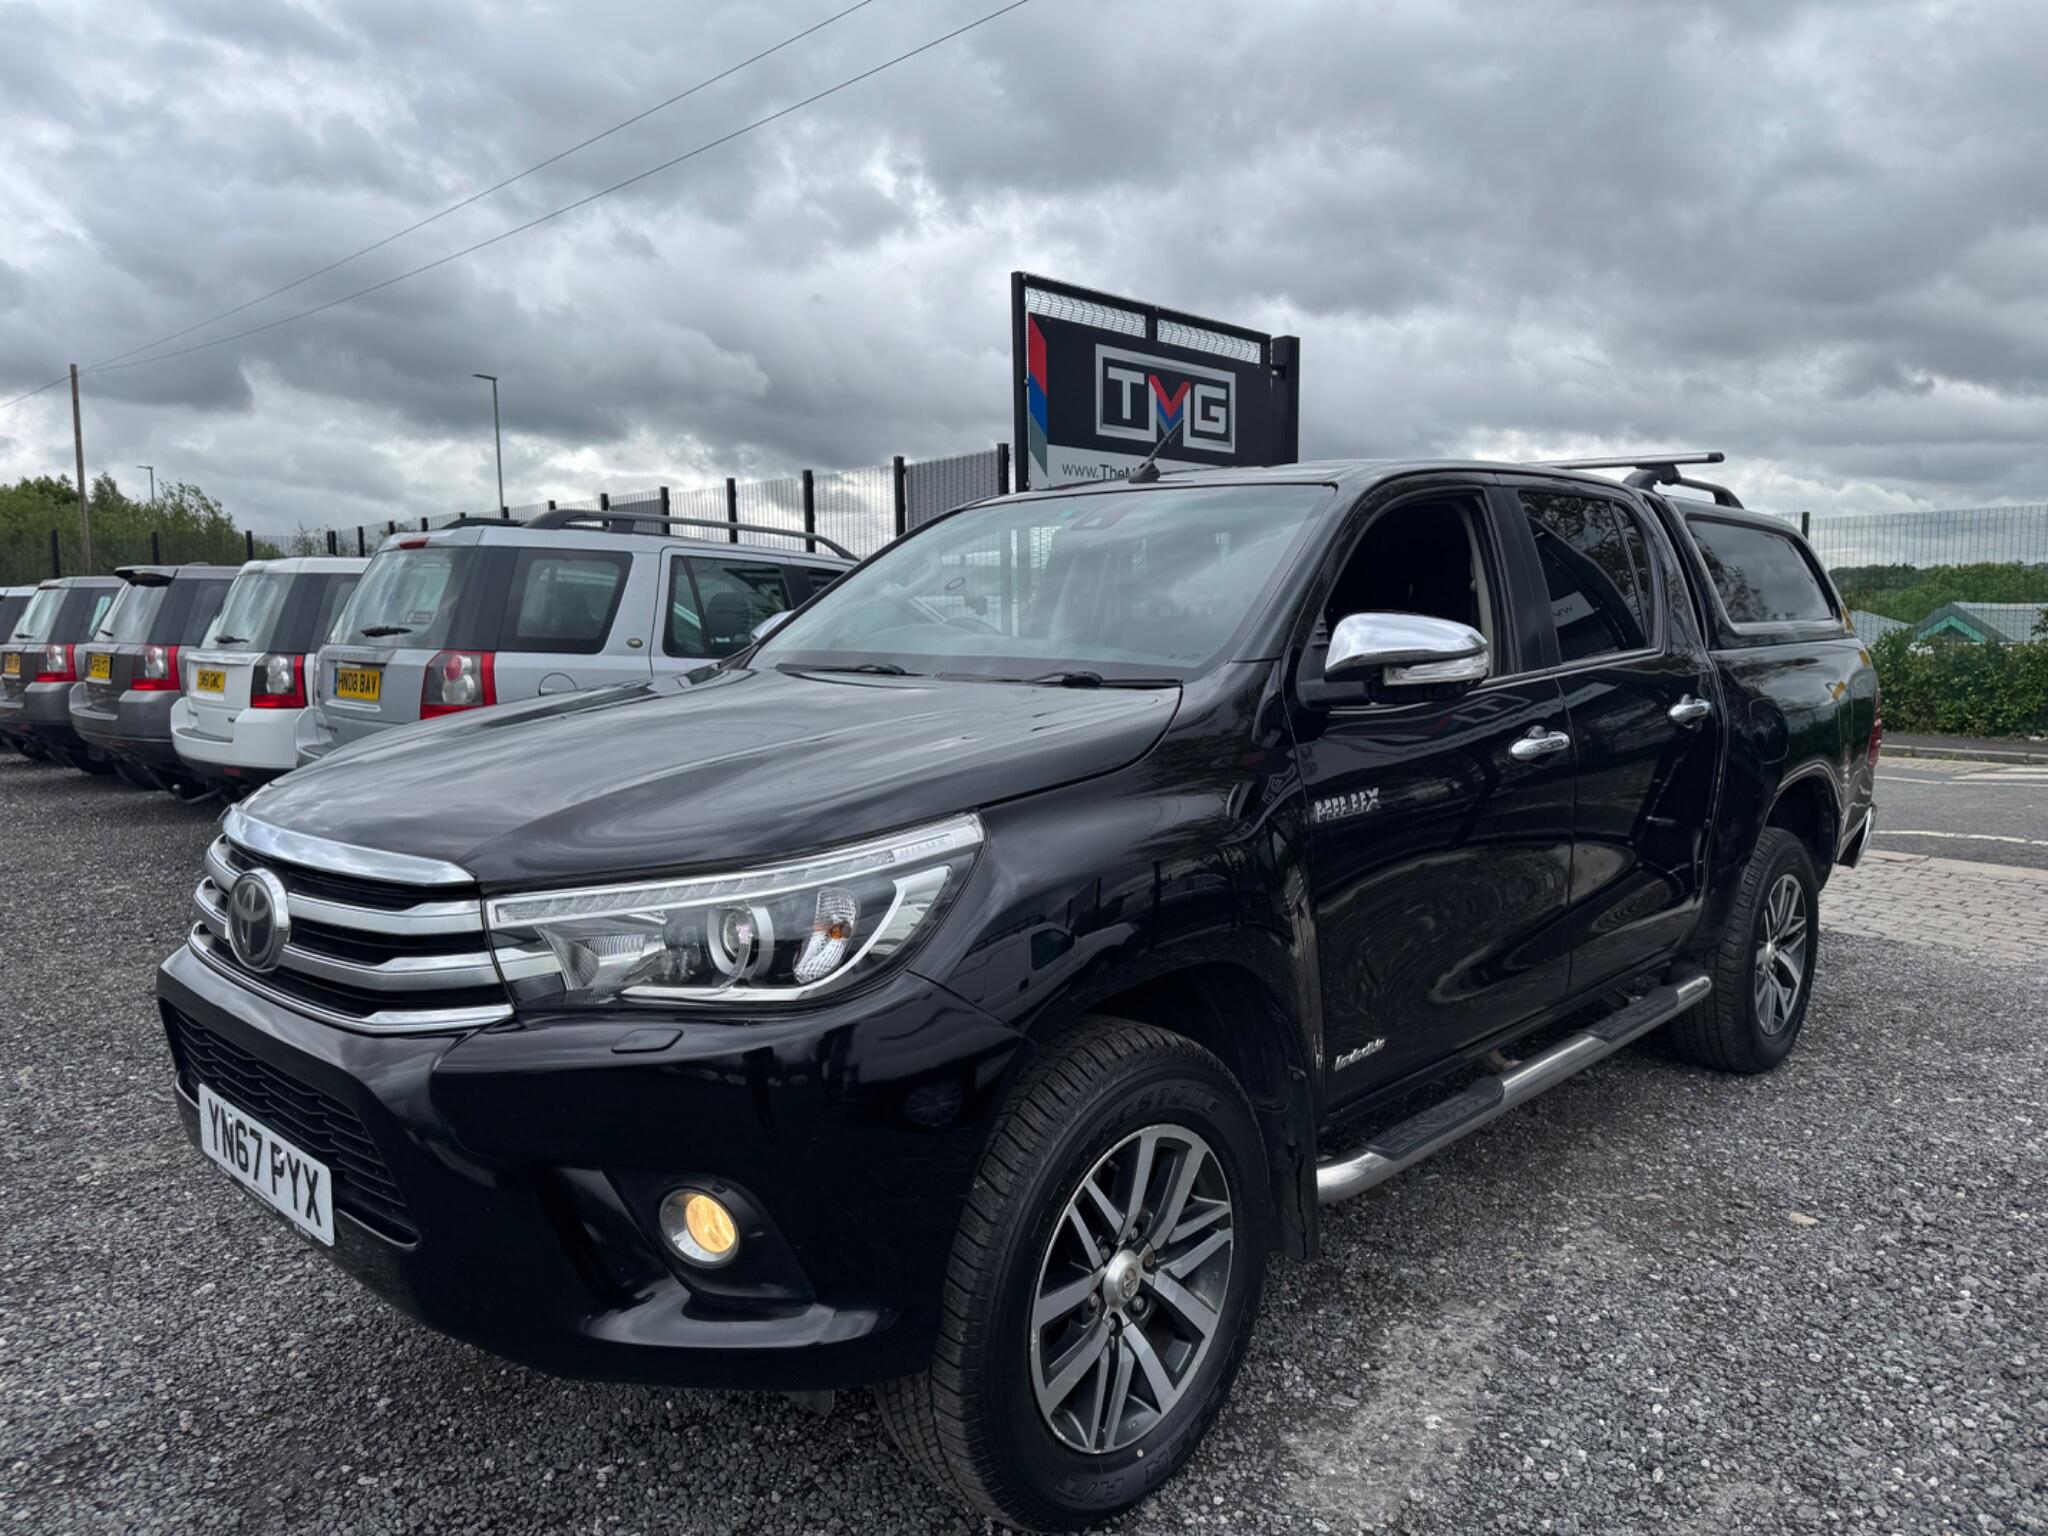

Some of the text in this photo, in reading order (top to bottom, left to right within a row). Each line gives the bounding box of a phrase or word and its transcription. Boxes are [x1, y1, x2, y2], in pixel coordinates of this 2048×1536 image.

[1108, 365, 1227, 444] TMG
[208, 1097, 322, 1227] YN67 PYX
